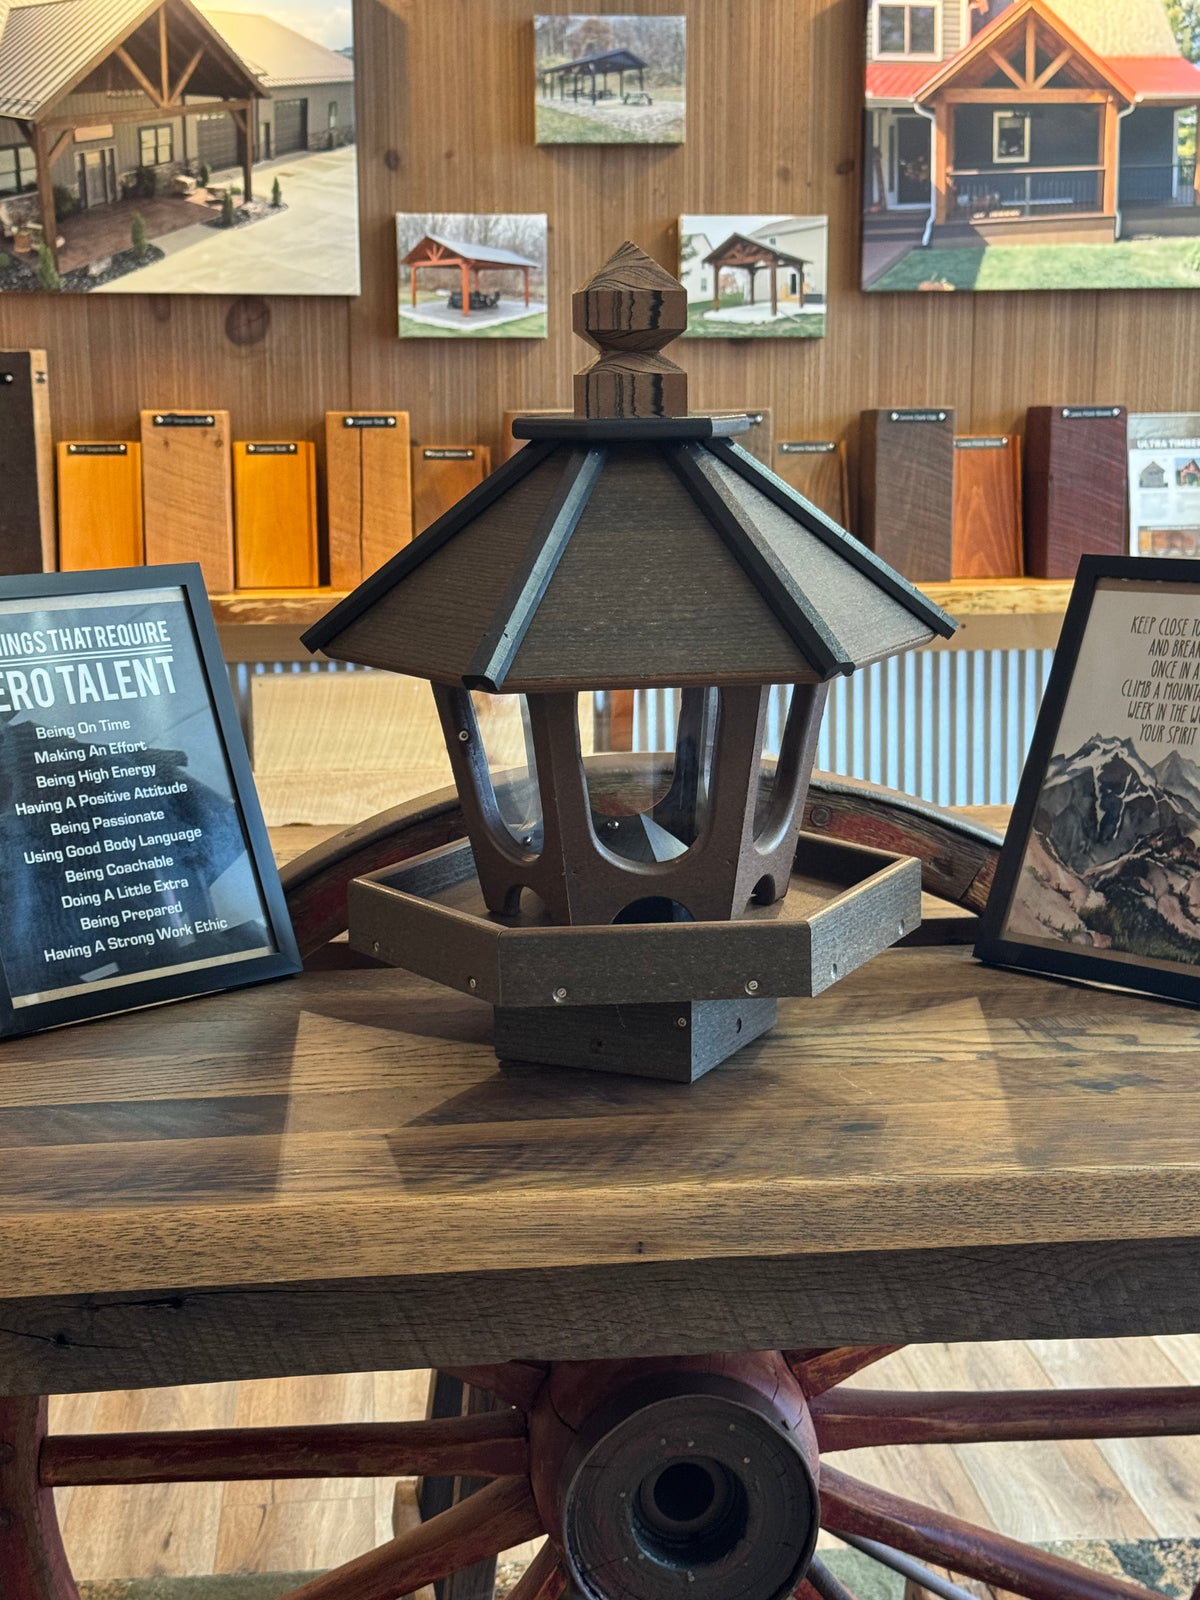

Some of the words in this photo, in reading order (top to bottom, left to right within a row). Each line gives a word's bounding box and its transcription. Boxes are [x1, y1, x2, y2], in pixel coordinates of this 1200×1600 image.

[0, 631, 47, 656] INGS
[46, 626, 93, 651] THAT
[93, 620, 171, 648] REQUIRE
[1130, 616, 1157, 634] KEEP
[1158, 617, 1189, 636] CLOSE
[1148, 639, 1170, 656] AND
[55, 655, 176, 705] TALENT
[1150, 659, 1178, 679] ONCE
[1179, 661, 1192, 679] IN
[1192, 662, 1200, 680] A
[1121, 679, 1152, 698] CLIMB
[1152, 681, 1161, 700] A
[1127, 700, 1155, 720] WEEK
[1155, 703, 1168, 721] IN
[1169, 704, 1188, 723] THE
[1190, 706, 1200, 724] W
[35, 725, 76, 739] Being
[78, 722, 97, 734] On
[98, 719, 131, 732] Time
[1139, 724, 1166, 743] YOUR
[1166, 725, 1198, 746] SPIRIT
[34, 748, 86, 764] Making
[89, 741, 108, 757] An
[110, 741, 148, 755] Effort
[36, 774, 76, 788] Being
[78, 768, 109, 784] High
[111, 764, 156, 778] Energy
[15, 800, 63, 816] Having
[66, 796, 77, 809] A
[79, 790, 131, 807] Positive
[134, 781, 188, 800] Attitude
[50, 821, 90, 836] Being
[93, 810, 165, 829] Passionate
[23, 849, 64, 864] Using
[65, 841, 102, 858] Good
[103, 837, 136, 852] Body
[138, 828, 202, 847] Language
[65, 868, 104, 883] Being
[106, 855, 174, 876] Coachable
[61, 893, 101, 909] Doing
[104, 888, 115, 901] A
[117, 883, 152, 899] Little
[154, 878, 189, 893] Extra
[80, 915, 120, 930] Being
[122, 901, 183, 922] Prepared
[44, 945, 92, 962] Having
[95, 940, 106, 953] A
[107, 933, 155, 950] Strong
[156, 920, 193, 940] Work
[194, 917, 228, 933] Ethic
